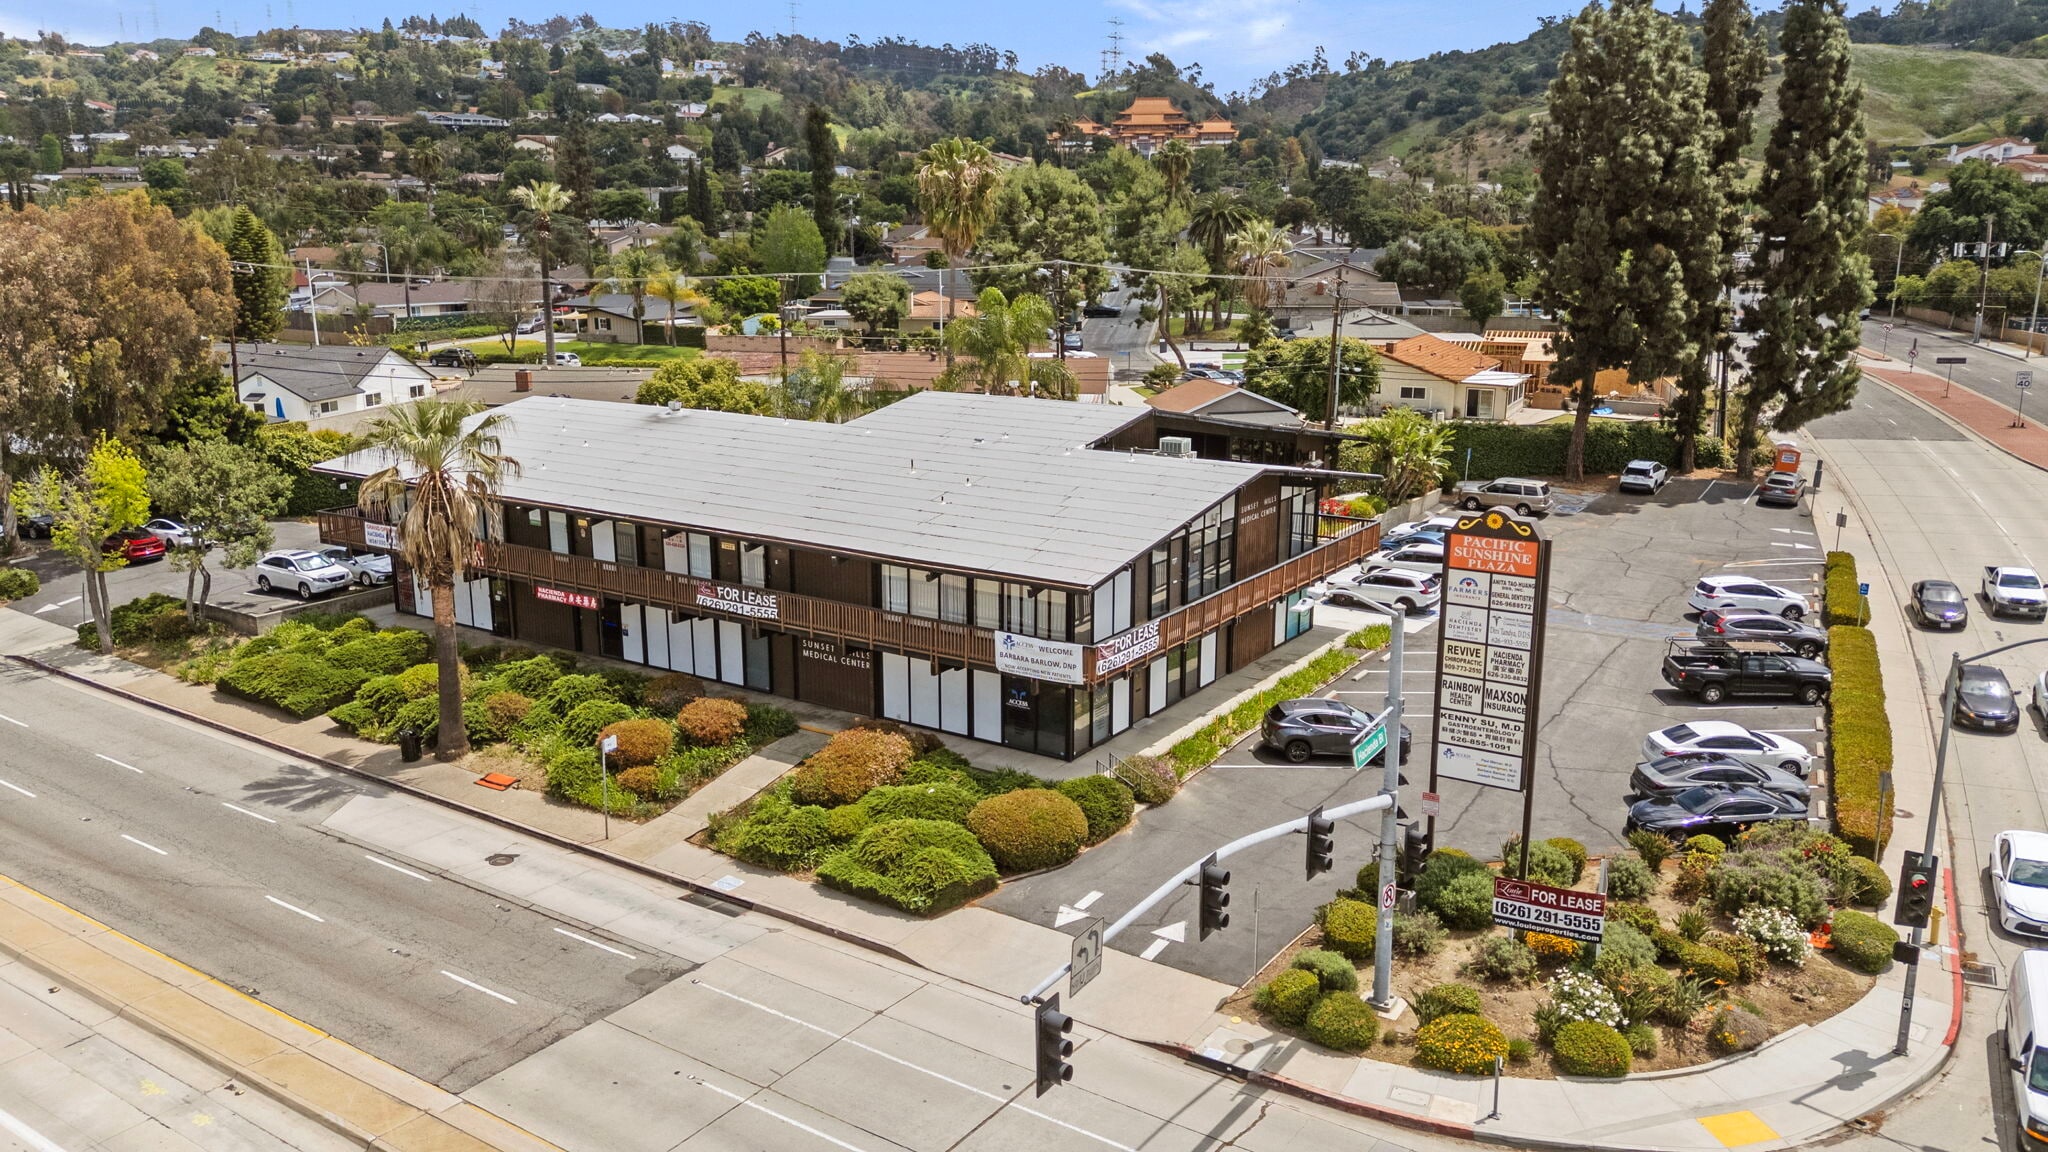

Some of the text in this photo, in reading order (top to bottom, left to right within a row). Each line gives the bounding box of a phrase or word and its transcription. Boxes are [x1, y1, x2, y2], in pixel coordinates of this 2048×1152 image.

[1241, 501, 1259, 514] SUNSET
[1240, 506, 1276, 524] MEDICAL CENTER
[1463, 535, 1526, 552] PACIFIC
[1454, 547, 1532, 565] SUNSHINE
[1468, 559, 1516, 573] PLAZA
[537, 586, 565, 597] HACIENDA
[537, 592, 567, 603] PHARMACY
[717, 586, 740, 601] FOR
[742, 590, 777, 608] LEASE
[1449, 586, 1489, 596] FARMERS
[1491, 592, 1535, 602] GENERAL DENTISTRY
[699, 597, 777, 618] (626)291-5555
[1448, 623, 1482, 632] DENTISTRY
[1449, 618, 1482, 627] HACIENDA
[1114, 633, 1132, 654] FOR
[1133, 621, 1160, 645] LEASE
[802, 639, 835, 652] SUNSET
[1038, 645, 1074, 656] WELCOME
[1447, 645, 1481, 658] REVIVE
[802, 649, 871, 669] MEDICAL CENTER
[999, 651, 1077, 670] BARBARA BARLOW, DNP
[1097, 638, 1158, 673] (626)291-5555
[1444, 656, 1483, 667] CHIROPRACTIC
[1493, 650, 1523, 661] HACIENDA
[1016, 666, 1040, 674] ACCEPTING
[1490, 658, 1525, 669] PHARMACY
[1442, 680, 1482, 694] RAINBOW
[1449, 698, 1473, 707] CENTER
[1450, 692, 1473, 701] HEALTH
[1485, 688, 1527, 706] MAXSON
[1484, 701, 1527, 715] INSURANCE
[1440, 712, 1524, 733] KENNY SU, M.D.
[1447, 721, 1517, 738] GASTROENTEROLOGY
[1450, 735, 1511, 751] 626-855-1091
[1498, 882, 1602, 912] Louie FOR LEASE
[1495, 901, 1600, 931] (626) 291-5555
[1494, 917, 1600, 941] www.louieproperties.com
